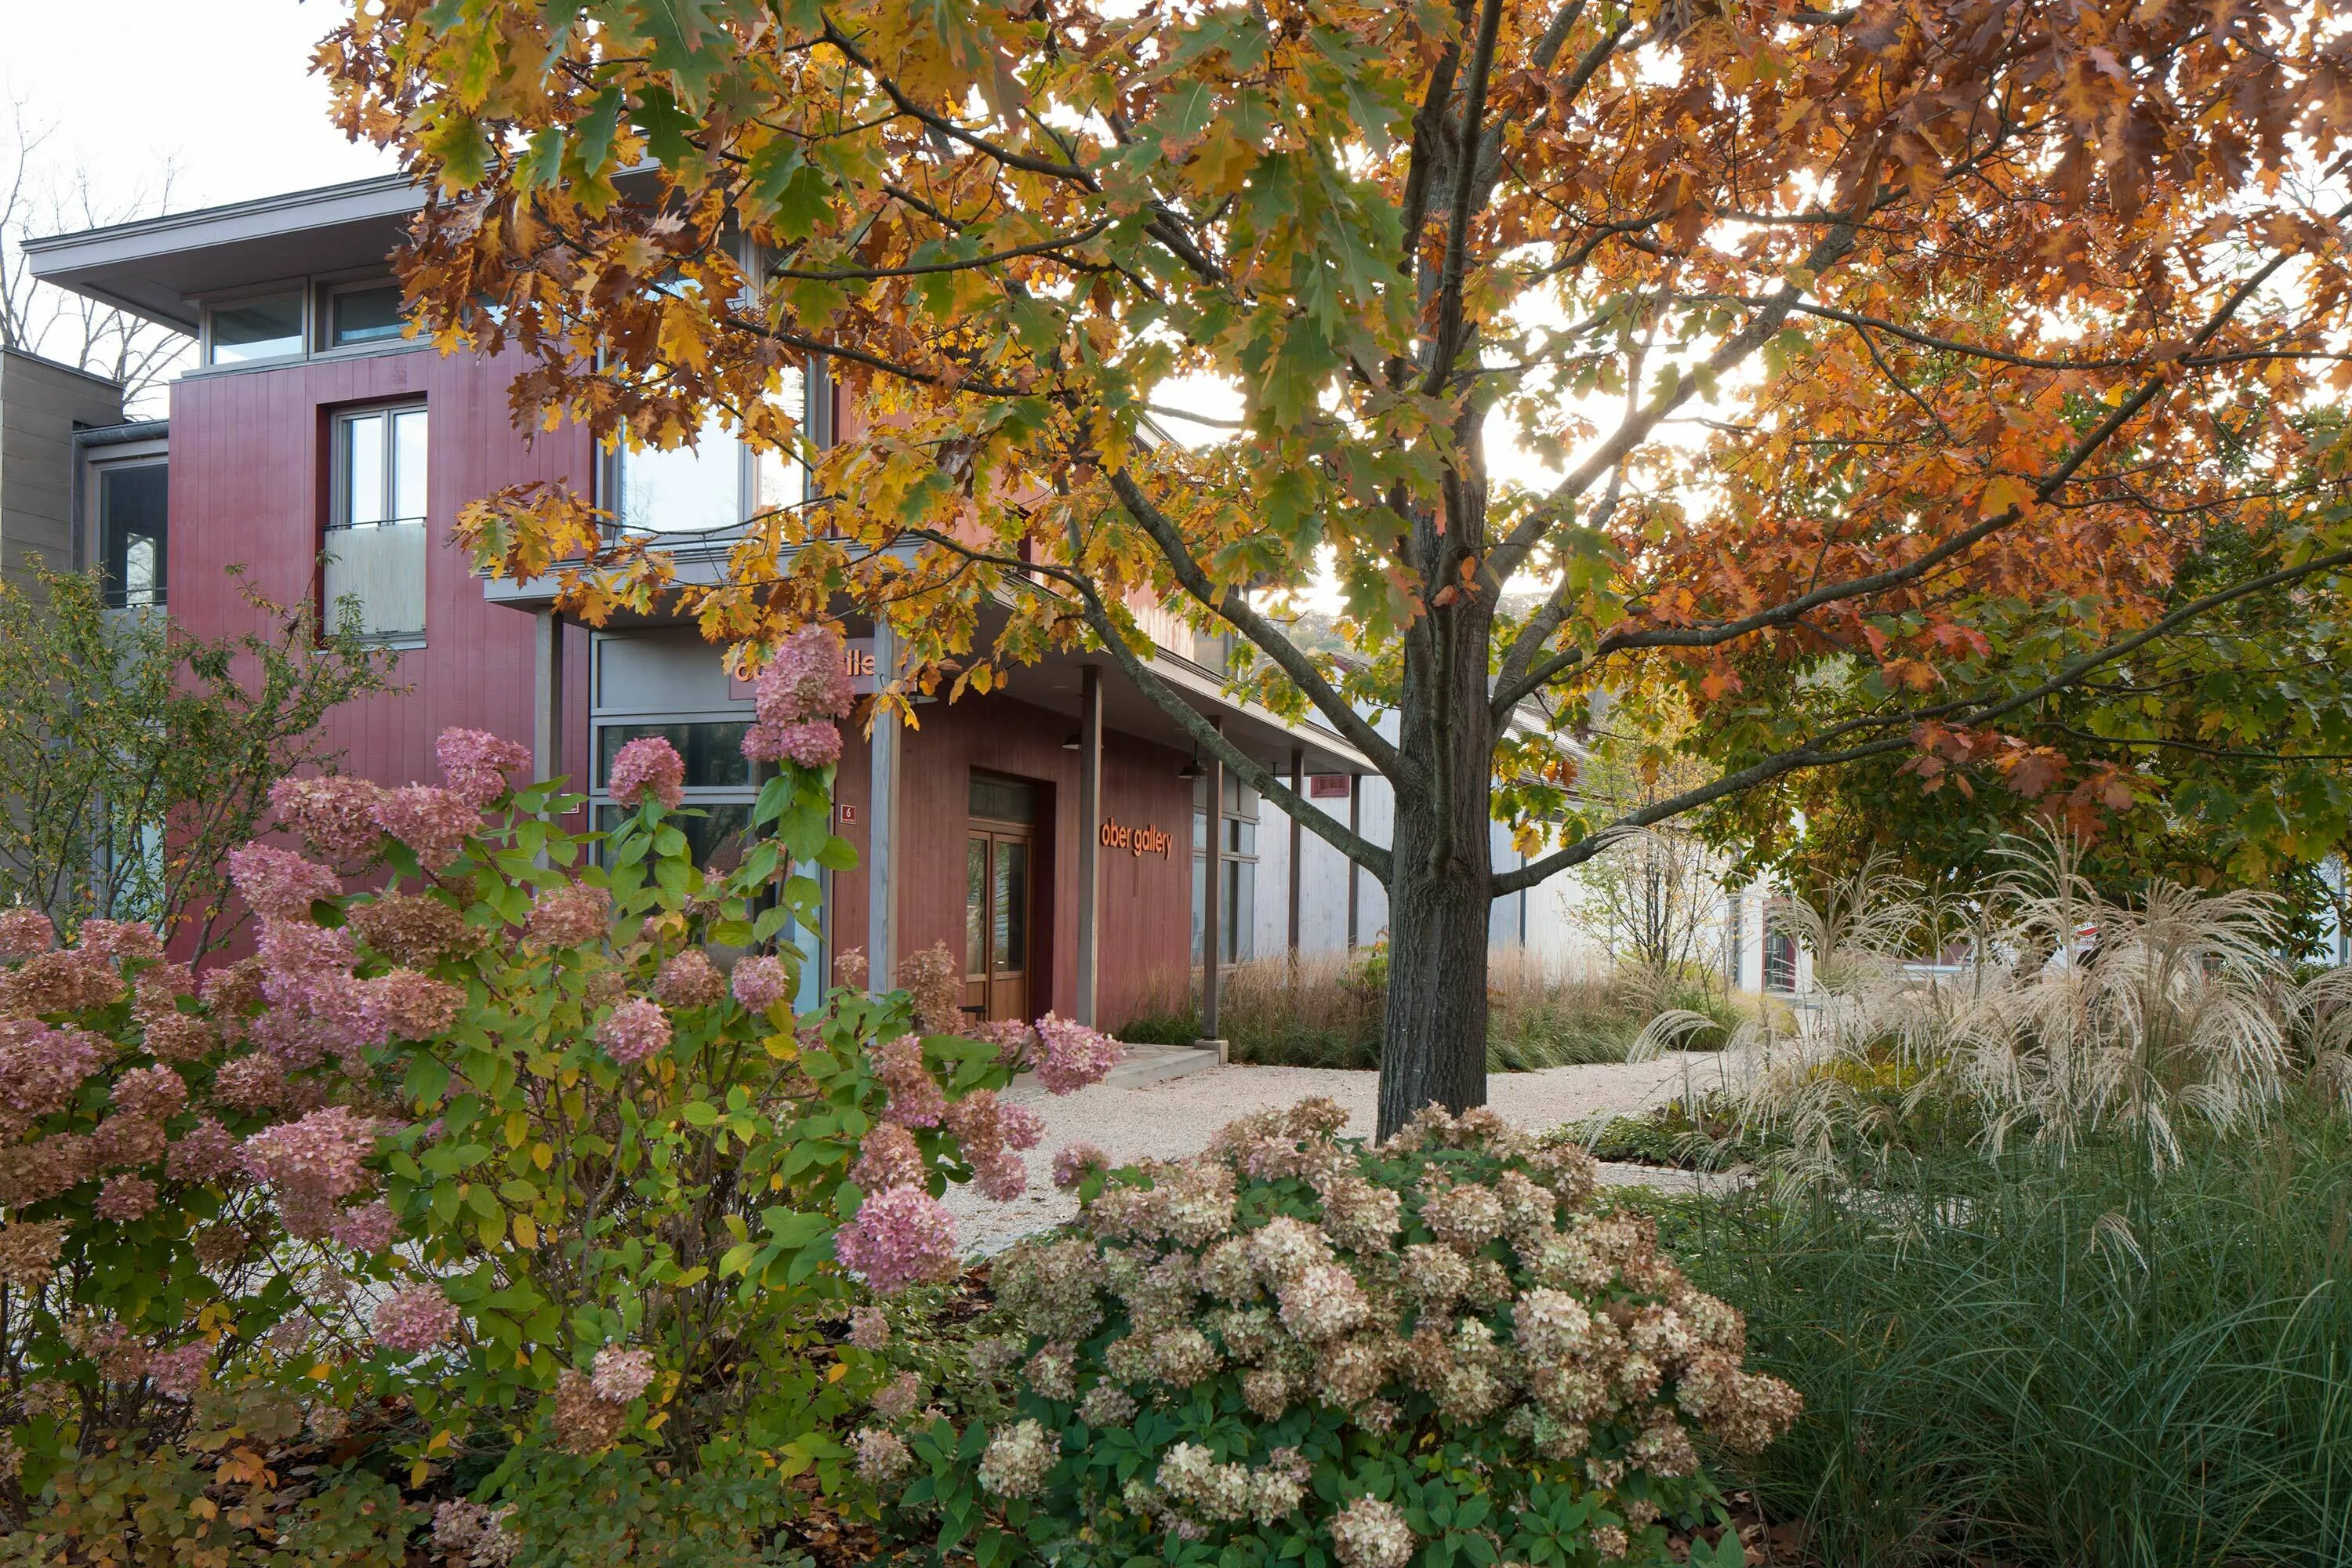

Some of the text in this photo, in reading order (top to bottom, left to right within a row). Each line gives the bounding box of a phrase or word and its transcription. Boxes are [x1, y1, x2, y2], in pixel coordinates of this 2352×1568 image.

[846, 808, 851, 818] 6
[1102, 816, 1173, 860] ober gallery
